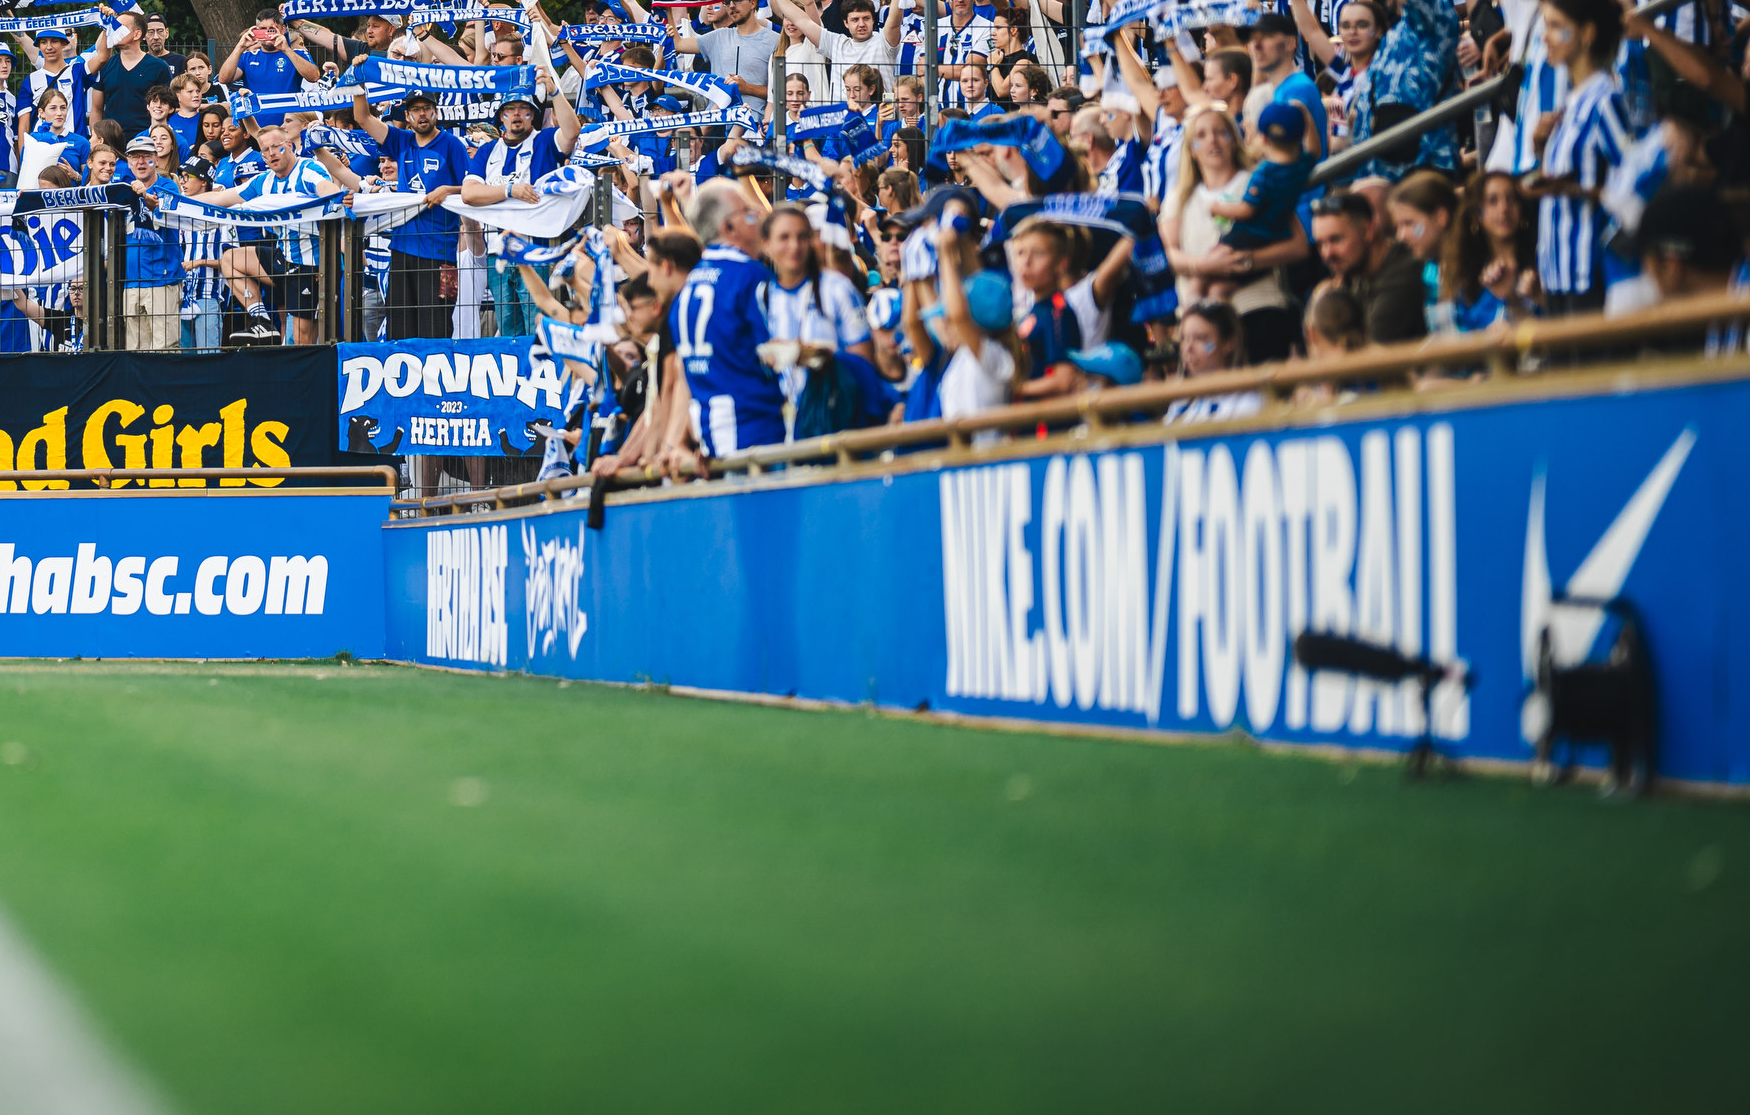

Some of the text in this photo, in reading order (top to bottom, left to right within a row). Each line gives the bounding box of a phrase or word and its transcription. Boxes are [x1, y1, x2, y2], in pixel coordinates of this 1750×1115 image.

[26, 19, 59, 29] GEGEN
[61, 16, 84, 25] ALLE
[580, 23, 660, 36] BERLIN
[379, 62, 496, 89] HERTHA BSC
[437, 101, 500, 120] THA BSC
[604, 118, 646, 134] RTHA
[651, 113, 683, 129] UND
[688, 109, 723, 125] DER
[42, 185, 108, 208] BERLIN
[340, 352, 563, 415] DONNA
[441, 401, 462, 413] 2023
[82, 398, 292, 488] Girls
[410, 417, 492, 446] HERTHA
[427, 527, 480, 663] HERTHA
[480, 525, 508, 666] BSC
